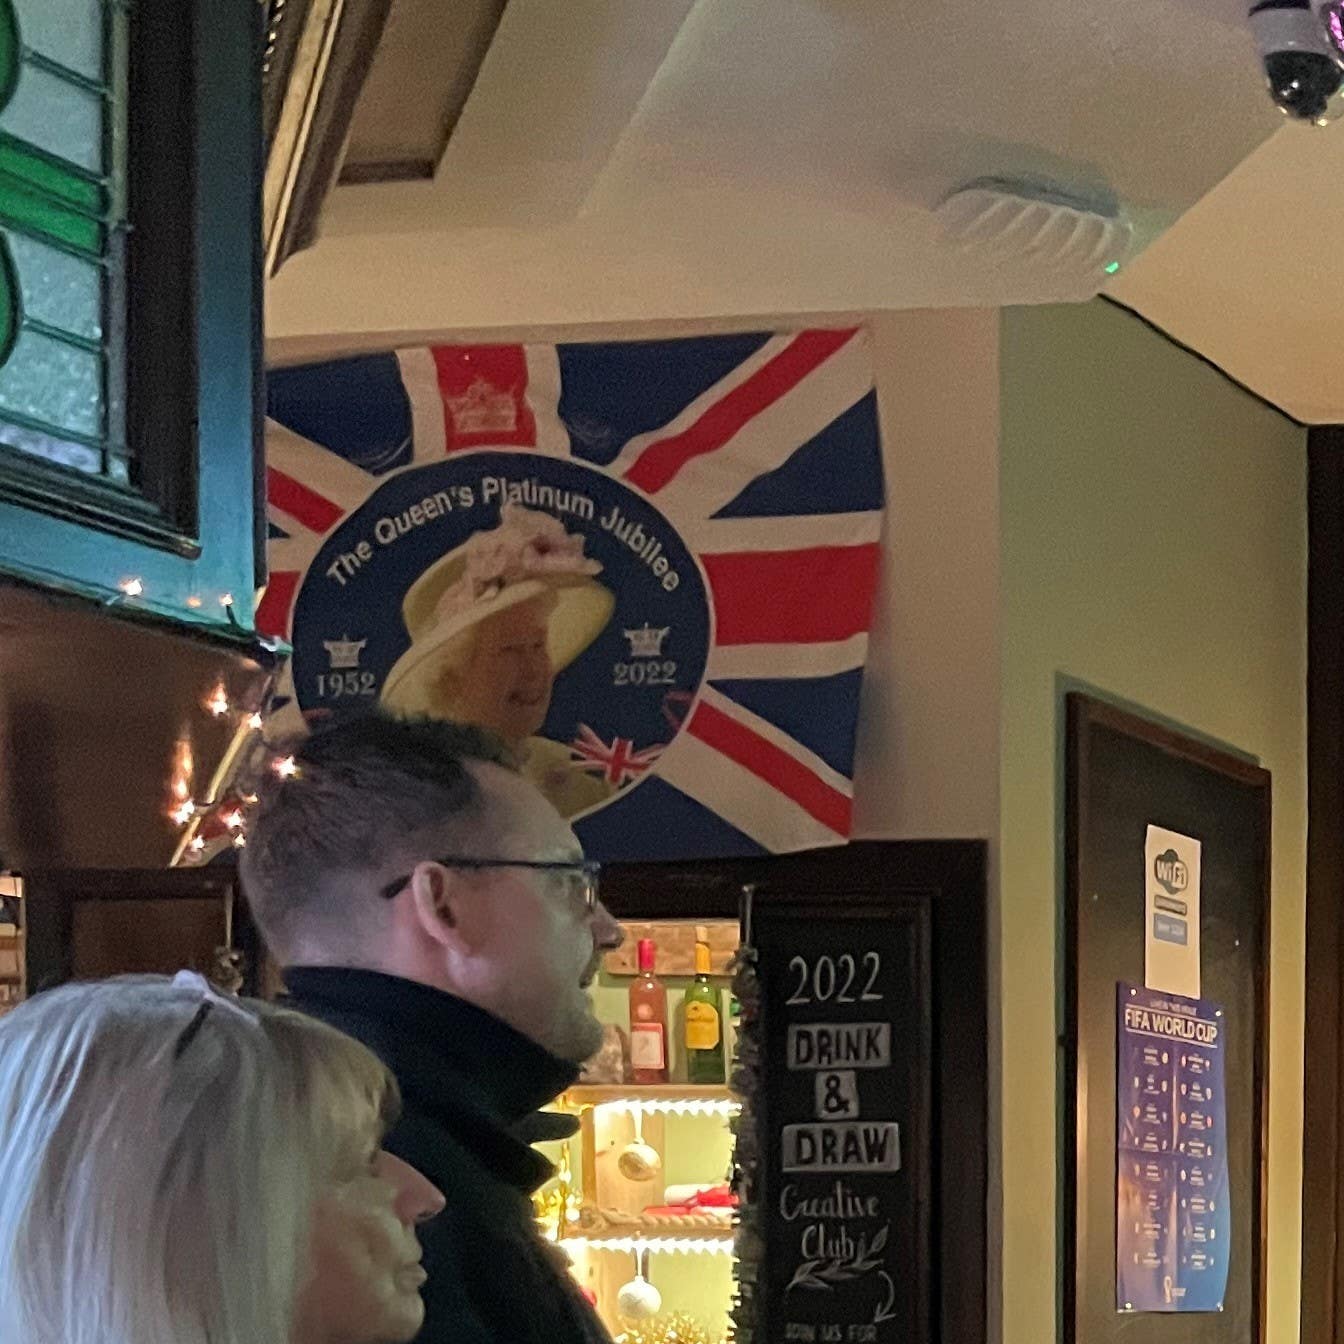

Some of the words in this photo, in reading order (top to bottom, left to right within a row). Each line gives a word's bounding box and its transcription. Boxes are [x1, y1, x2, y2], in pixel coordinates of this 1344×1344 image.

[326, 540, 374, 586] The
[374, 486, 475, 545] Queen's
[482, 477, 595, 520] Platinum
[601, 506, 680, 592] Jubilee
[316, 673, 376, 697] 1952
[614, 660, 676, 686] 2022
[785, 951, 883, 1005] 2022
[1125, 1008, 1151, 1031] FIFA
[1152, 1014, 1195, 1038] WORLD
[1196, 1023, 1218, 1043] CUP
[795, 1026, 883, 1065] DRINK
[824, 1074, 849, 1113] &
[796, 1127, 889, 1165] DRAW
[780, 1180, 880, 1220] Creative
[802, 1222, 855, 1260] Club
[822, 1324, 842, 1341] US
[848, 1324, 877, 1341] FOR
